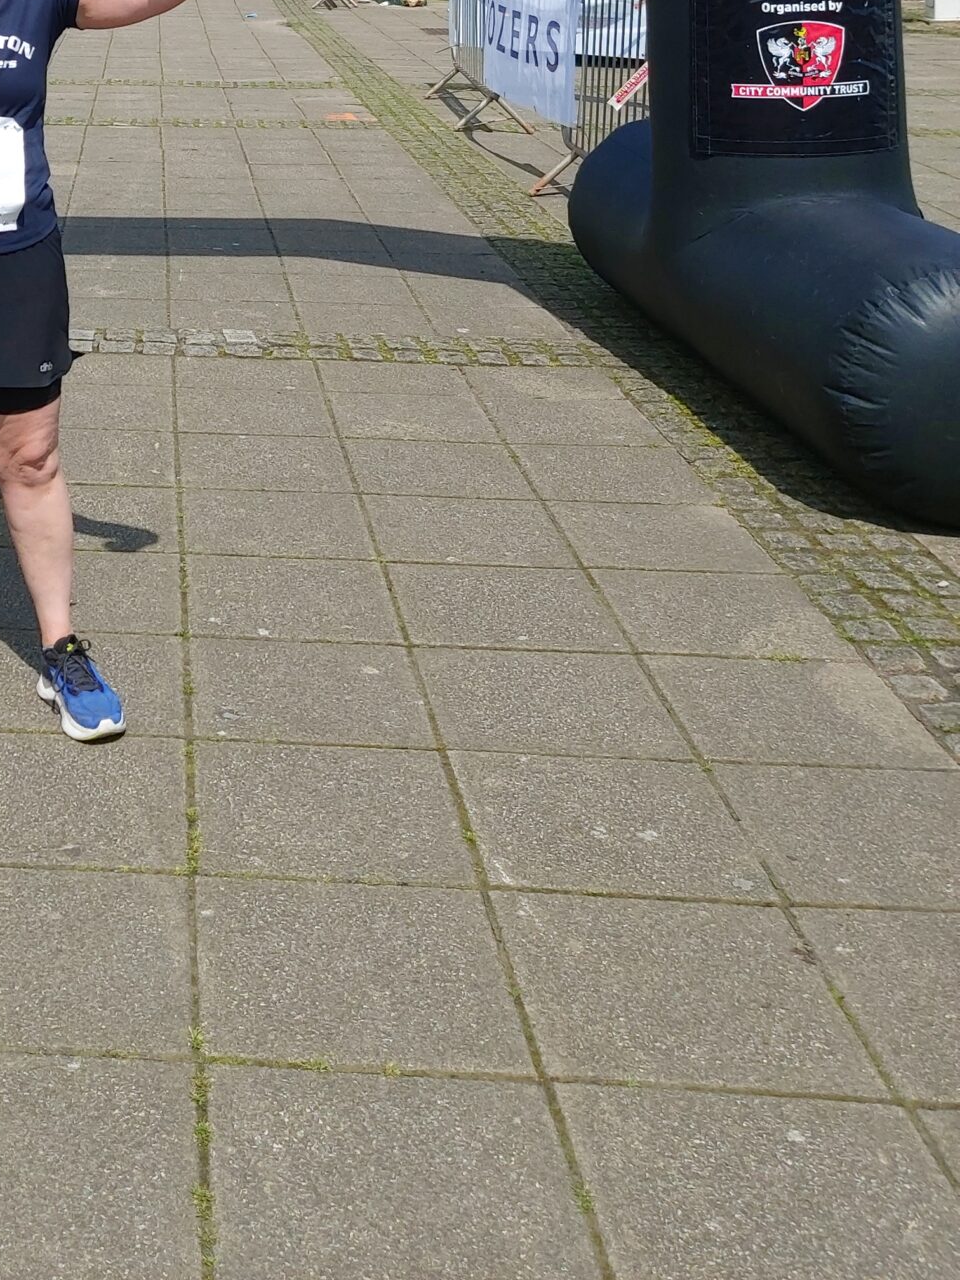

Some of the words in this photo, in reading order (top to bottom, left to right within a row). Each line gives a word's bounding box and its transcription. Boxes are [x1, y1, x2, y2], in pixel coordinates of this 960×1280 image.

[761, 0, 826, 15] Organised
[828, 0, 843, 13] by
[739, 86, 764, 96] CITY
[766, 85, 833, 97] COMMUNITY
[834, 83, 864, 95] TRUST
